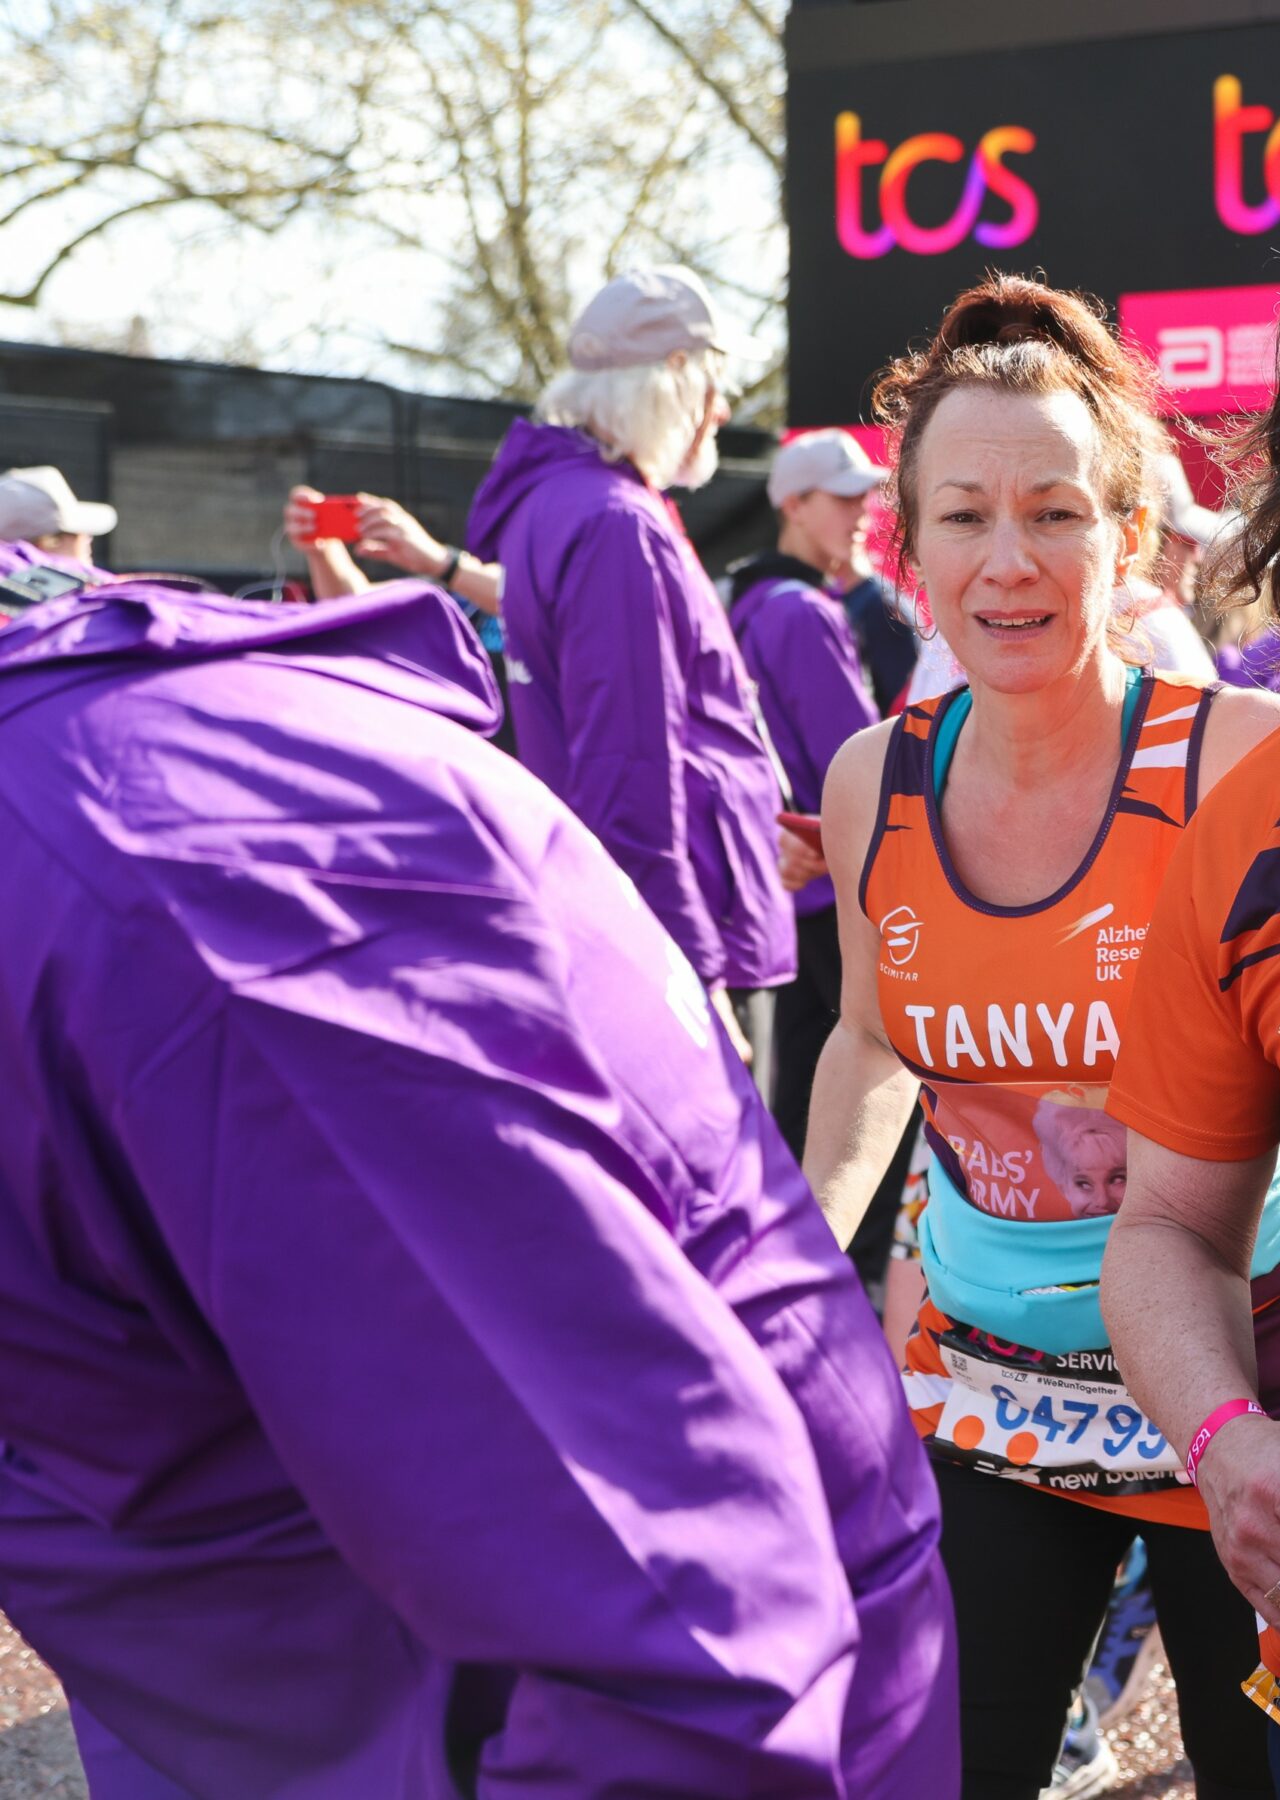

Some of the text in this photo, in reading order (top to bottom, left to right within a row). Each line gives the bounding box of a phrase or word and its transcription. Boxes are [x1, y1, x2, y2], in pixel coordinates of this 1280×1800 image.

[834, 110, 1040, 260] tcs
[1096, 946, 1143, 964] Rese
[879, 962, 919, 982] SCIMITAR
[1096, 964, 1123, 981] UK
[904, 1000, 1121, 1068] TANYA
[1036, 1375, 1119, 1396] #WeRunTogether
[1049, 1471, 1100, 1490] new
